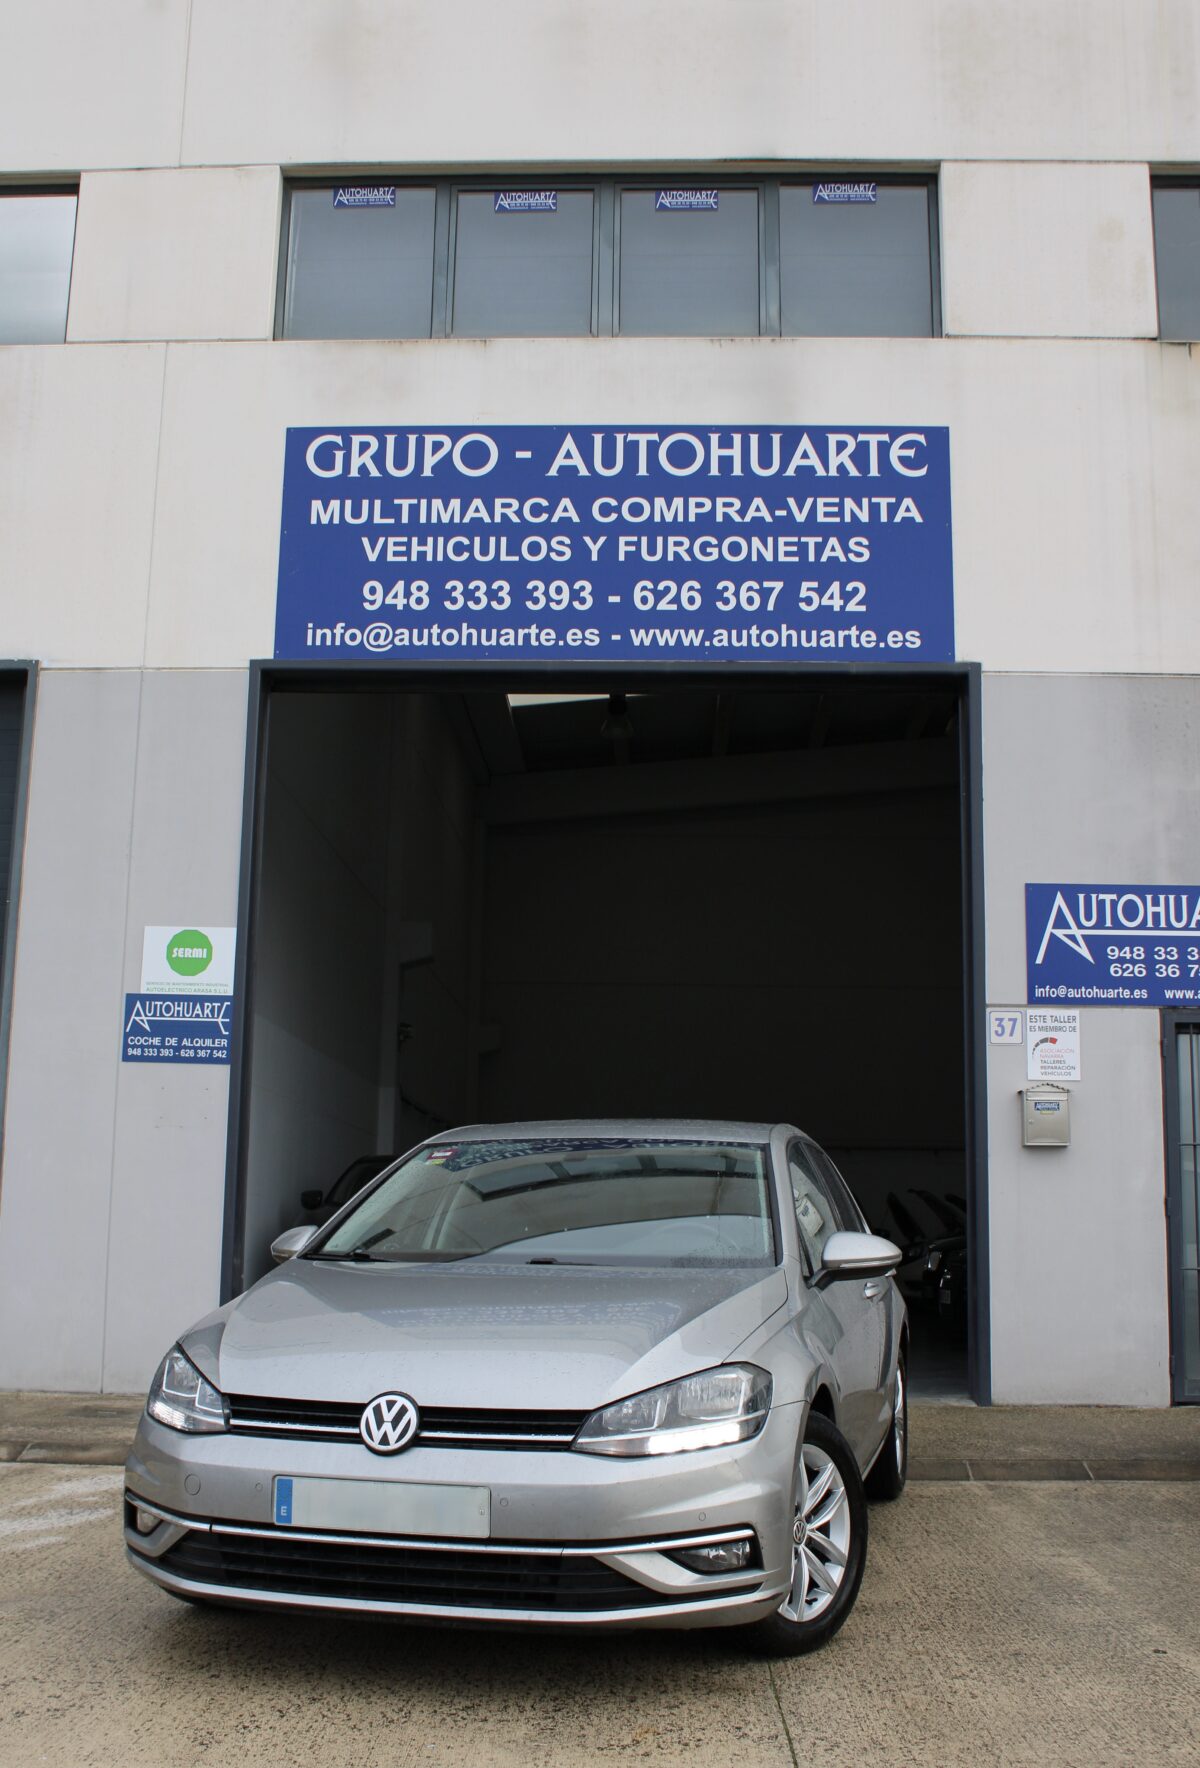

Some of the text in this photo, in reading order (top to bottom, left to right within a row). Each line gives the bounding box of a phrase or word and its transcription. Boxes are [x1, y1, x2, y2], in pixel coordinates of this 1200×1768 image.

[334, 187, 395, 206] AUTOHUARTE
[495, 192, 557, 210] AUTOHUARTE
[656, 189, 718, 208] AUTOHUARTE
[814, 183, 876, 202] AUTOHUARTE
[305, 432, 929, 478] GRUPO - AUTOHUARTE
[310, 497, 923, 524] MULTIMARCA COMPRA-VENTA
[361, 536, 871, 562] VEHICULOS Y FURGONETAS
[362, 580, 867, 612] 948 333 393 - 626 367 542
[306, 622, 600, 652] info@autohuarte.es
[630, 624, 921, 648] www.autohuarte.es
[172, 947, 207, 959] SERMI
[1106, 946, 1200, 961] 948 33 3
[1109, 963, 1200, 978] 626 36 7
[1035, 985, 1200, 1000] info@autohuarte.es www.
[126, 1000, 230, 1034] AUTOHUARTE
[1029, 1015, 1077, 1024] ESTE TALLER
[994, 1018, 1018, 1037] 37
[128, 1036, 228, 1048] COCHE DE ALQUILER
[127, 1048, 141, 1056] 948
[143, 1048, 158, 1057] 333
[159, 1049, 174, 1057] 393
[180, 1049, 195, 1058] 626
[196, 1050, 211, 1058] 367
[212, 1050, 227, 1058] 542
[280, 1506, 288, 1516] E
